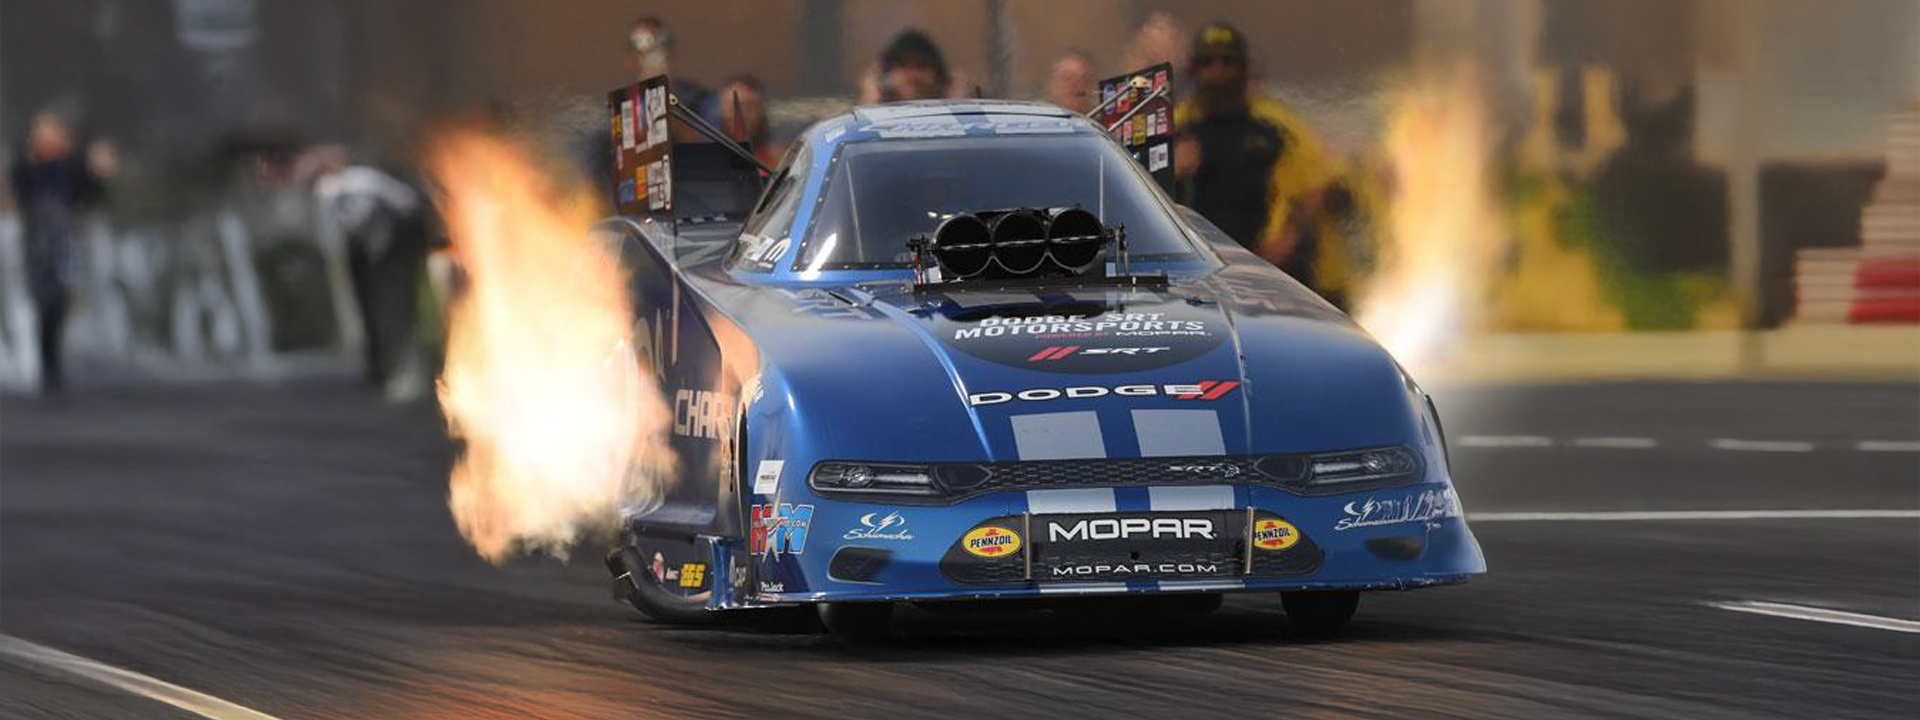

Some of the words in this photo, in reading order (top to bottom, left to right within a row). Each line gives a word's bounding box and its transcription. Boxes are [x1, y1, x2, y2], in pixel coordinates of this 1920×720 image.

[980, 314, 1087, 327] DODGE
[1104, 312, 1165, 322] SRT
[955, 321, 1205, 340] MOTORSPORTS
[1080, 346, 1171, 355] SRT
[969, 385, 1204, 406] DODGE
[1049, 518, 1215, 542] MOPAR
[970, 535, 1012, 548] PENNZOIL
[1053, 563, 1218, 576] MOPAR.COM
